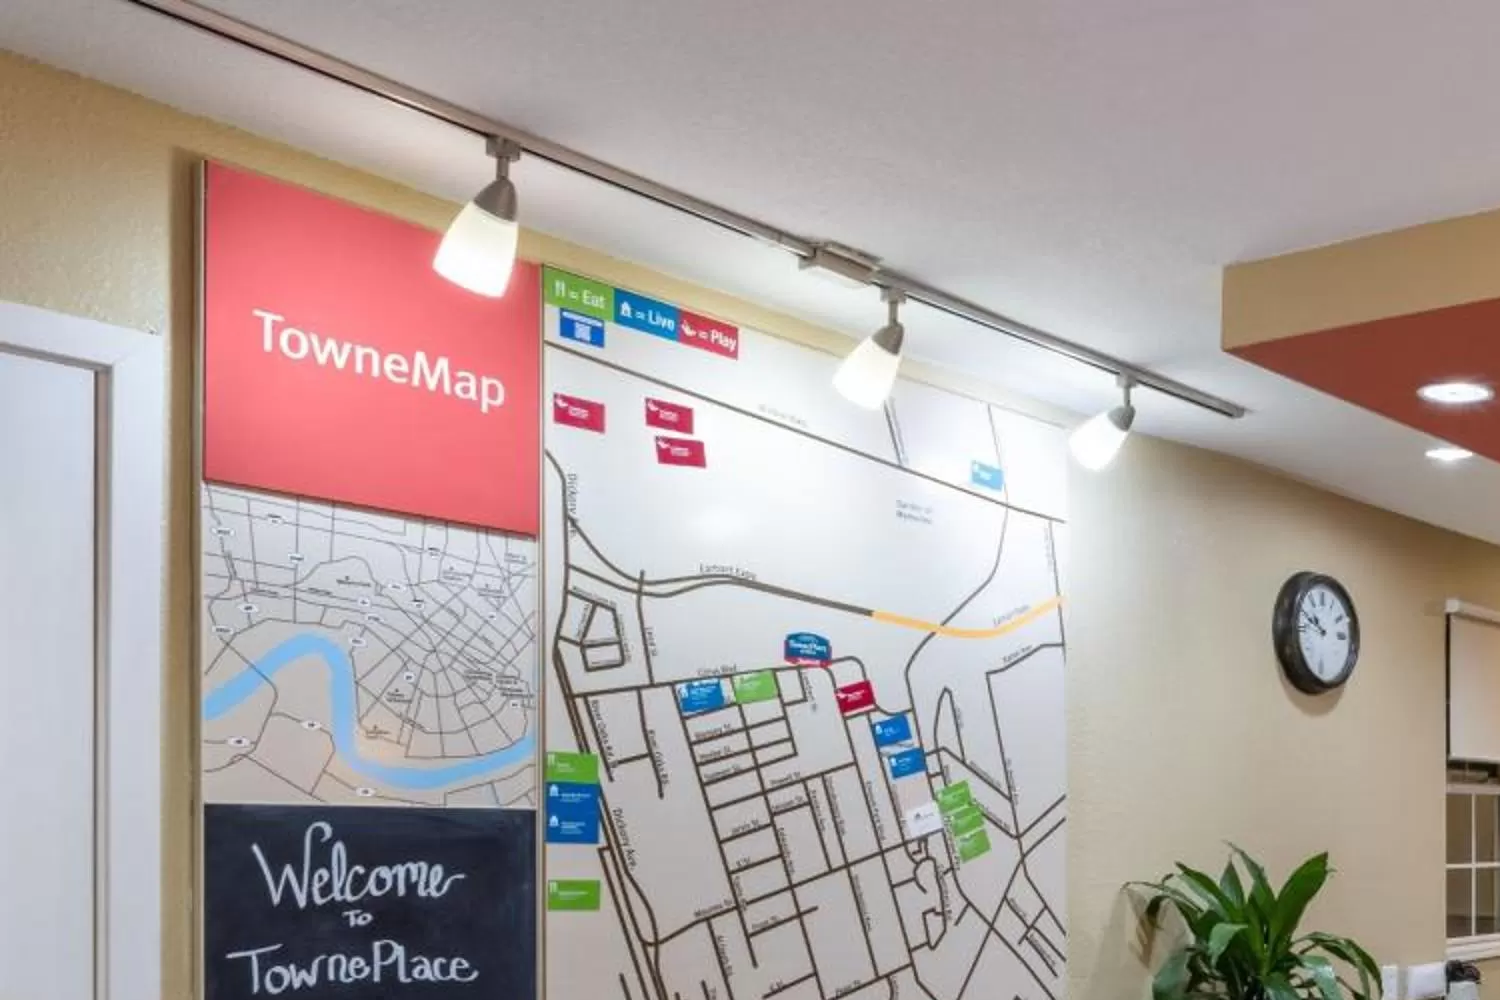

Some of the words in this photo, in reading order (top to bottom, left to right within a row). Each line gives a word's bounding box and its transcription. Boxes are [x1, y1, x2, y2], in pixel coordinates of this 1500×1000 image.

[582, 291, 605, 309] Eat
[648, 309, 675, 331] Live
[710, 328, 737, 352] Play
[252, 308, 505, 412] TowneMap
[252, 821, 466, 909] Welcome
